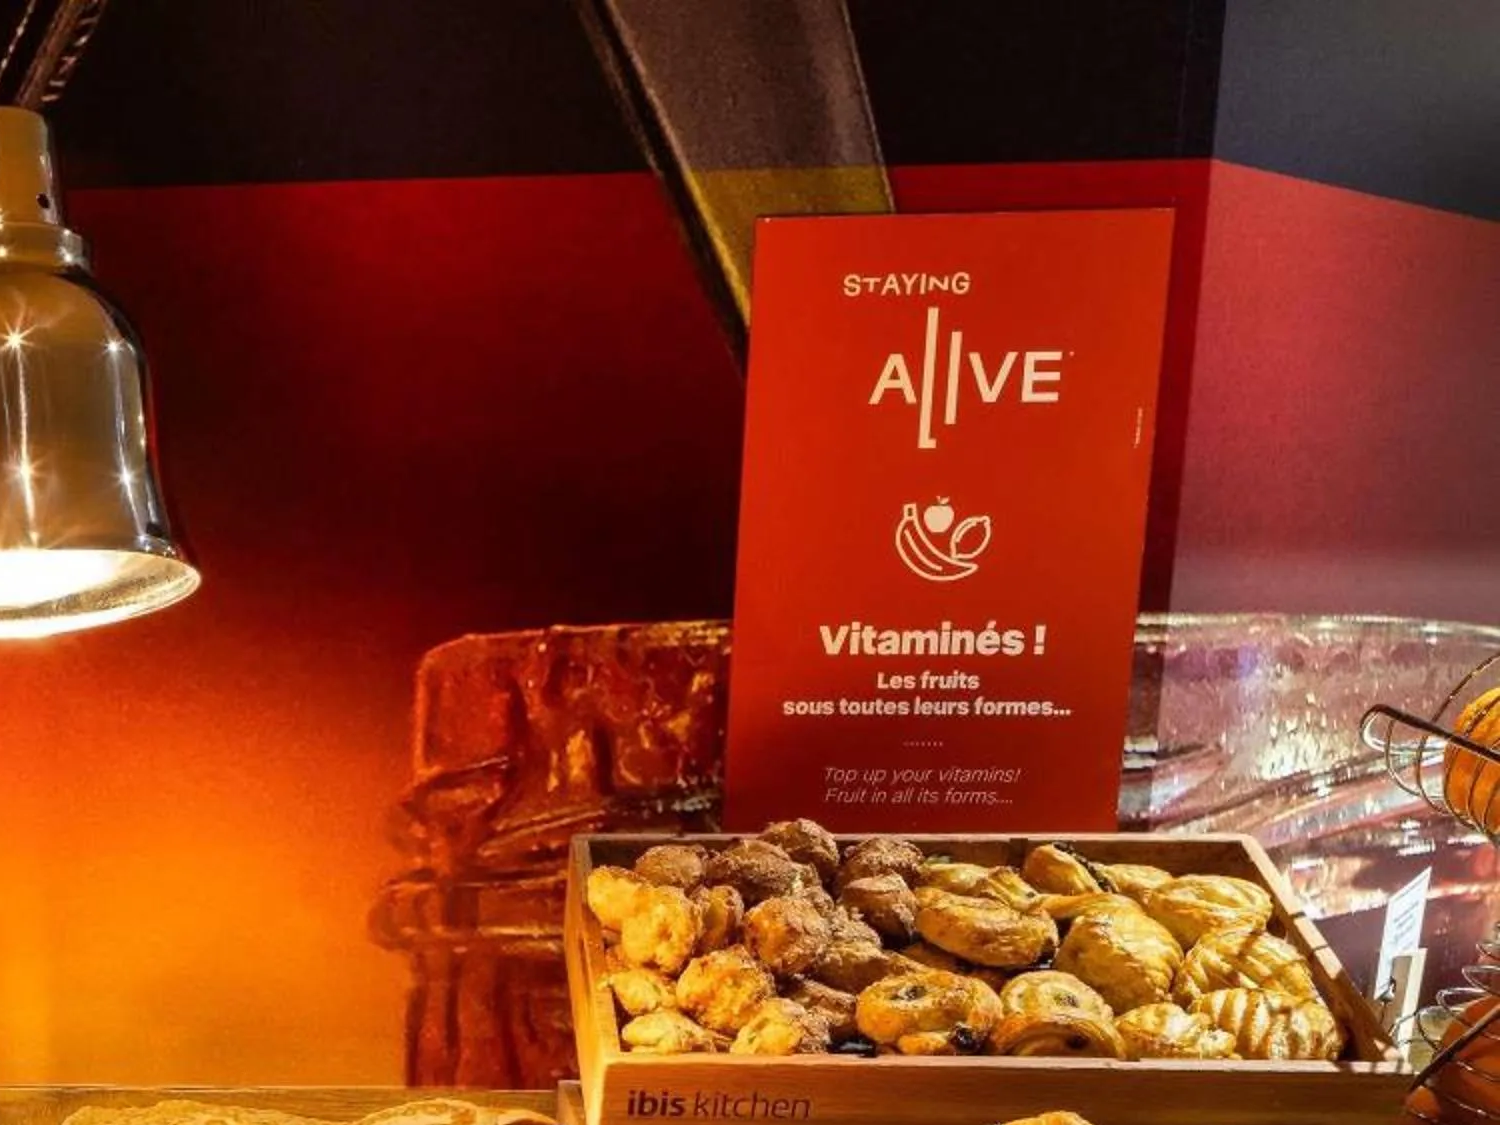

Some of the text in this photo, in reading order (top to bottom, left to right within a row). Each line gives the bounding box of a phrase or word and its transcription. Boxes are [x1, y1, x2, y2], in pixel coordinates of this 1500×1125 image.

[843, 272, 970, 296] STAYING
[819, 620, 1047, 656] Vitaminés !
[876, 671, 980, 690] Les fruits
[783, 696, 1072, 716] sous toutes leurs formes...
[824, 765, 1022, 785] Top up your vitamins!
[825, 787, 868, 803] Fruit
[871, 787, 888, 804] in
[891, 787, 915, 804] all
[917, 787, 940, 803] its
[627, 1090, 811, 1120] ibis kitchen
